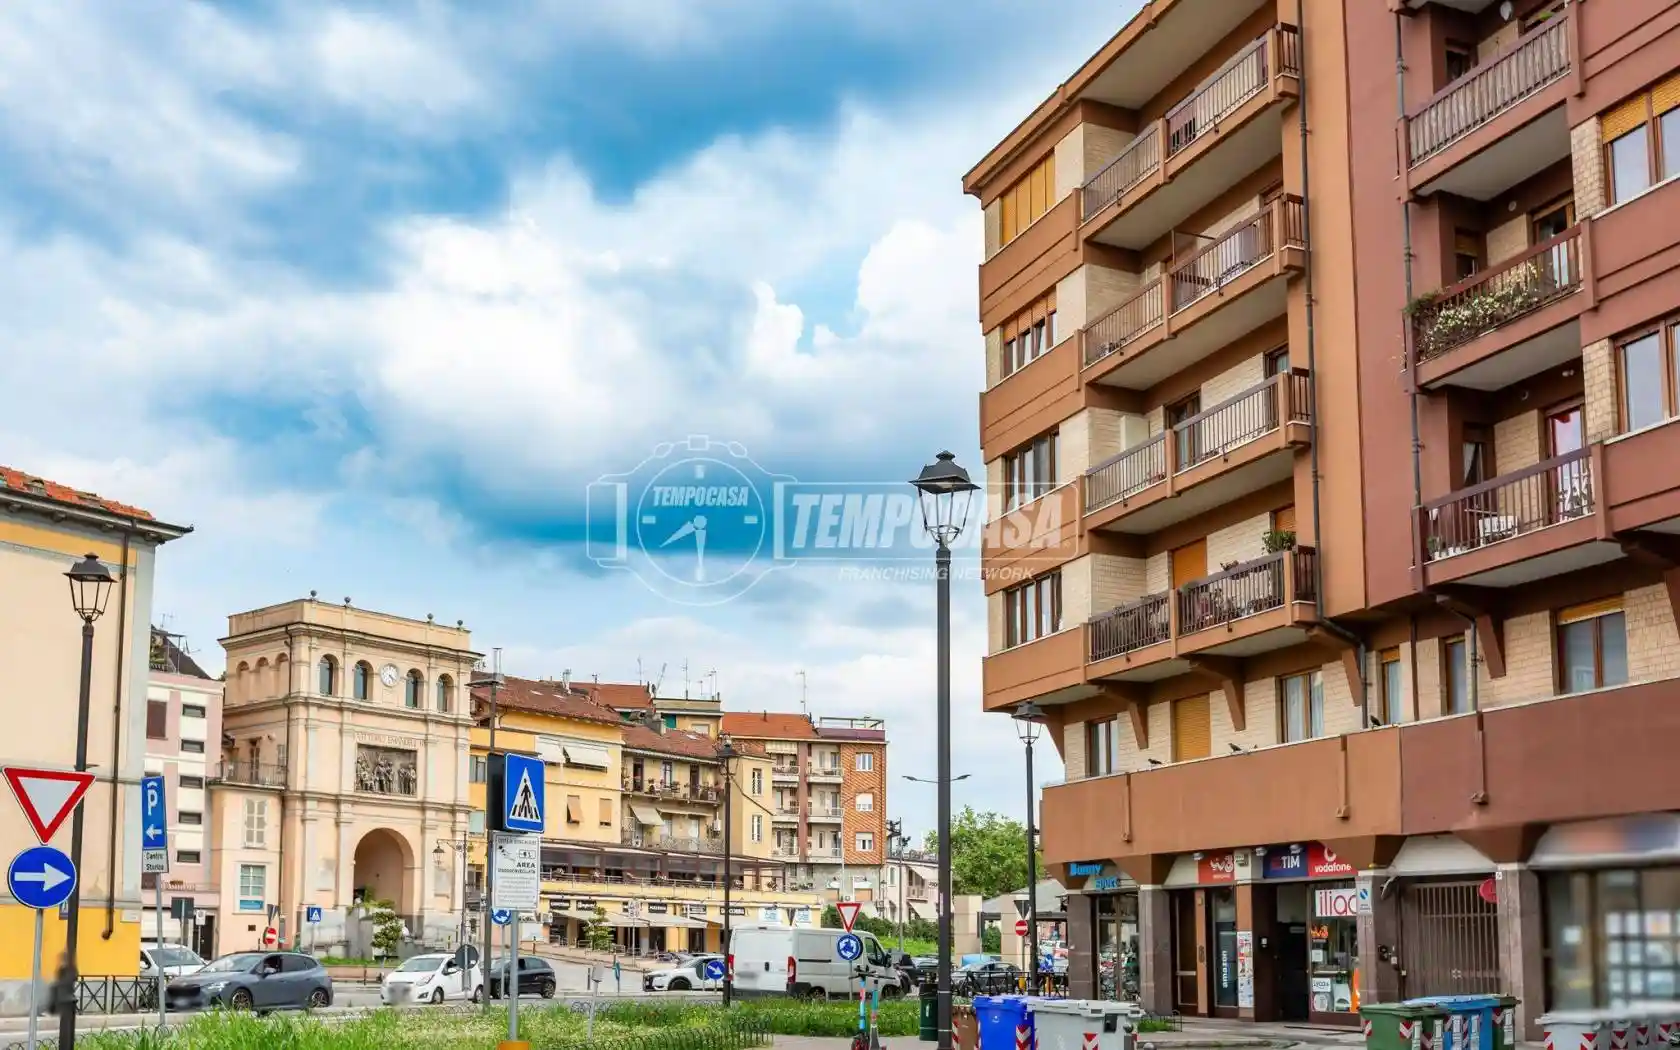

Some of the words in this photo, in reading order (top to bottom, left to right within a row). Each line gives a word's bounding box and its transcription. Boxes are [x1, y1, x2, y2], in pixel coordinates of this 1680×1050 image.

[147, 789, 158, 816] P
[516, 861, 536, 869] AREA
[1281, 855, 1300, 869] TIM
[1314, 862, 1352, 873] vodafone
[1221, 950, 1229, 989] amazon
